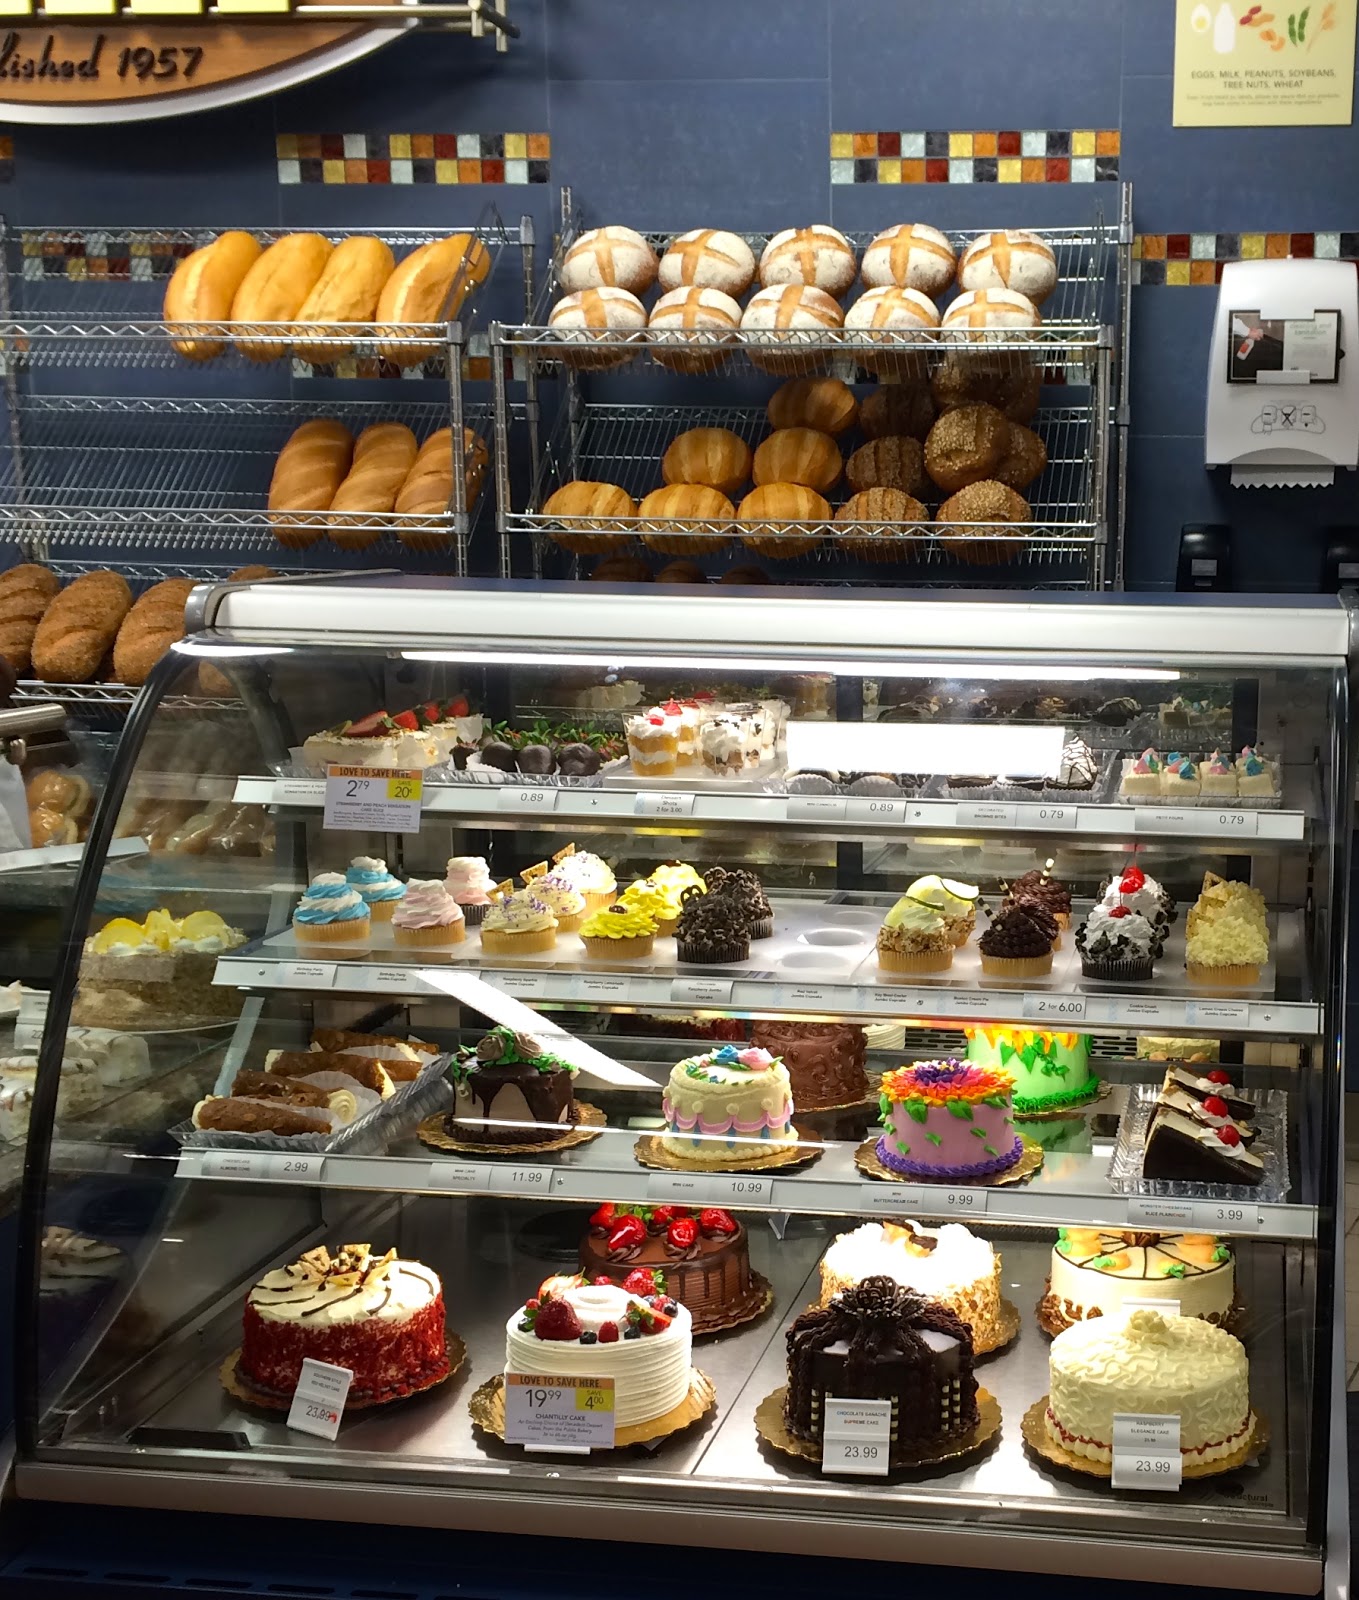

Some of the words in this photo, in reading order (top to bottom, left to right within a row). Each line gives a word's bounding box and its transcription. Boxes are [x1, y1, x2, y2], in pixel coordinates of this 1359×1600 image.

[116, 47, 204, 79] 1957
[1191, 70, 1215, 78] EGGS,
[1244, 69, 1286, 78] PEANUTS,
[1288, 69, 1336, 78] SOYBEANS,
[1223, 81, 1243, 89] TREE
[1274, 80, 1304, 88] WHEAT
[339, 767, 359, 776] LOVE
[360, 768, 370, 776] TO
[371, 768, 390, 778] SAVE
[520, 792, 544, 802] 0.89
[870, 802, 894, 812] 0.89
[1040, 810, 1064, 819] 0.79
[1219, 815, 1244, 825] 0.79
[1038, 1002, 1046, 1011] 2
[1058, 1002, 1082, 1012] 6.00
[284, 1161, 308, 1172] 2.99
[512, 1172, 543, 1183] 11.99
[731, 1182, 762, 1193] 10.99
[947, 1194, 973, 1205] 9.99
[1217, 1209, 1243, 1221] 3.99
[520, 1376, 540, 1385] LOVE
[544, 1377, 554, 1386] TO
[556, 1378, 577, 1387] SAVE
[844, 1445, 878, 1458] 23.99
[1136, 1460, 1170, 1473] 23.99
